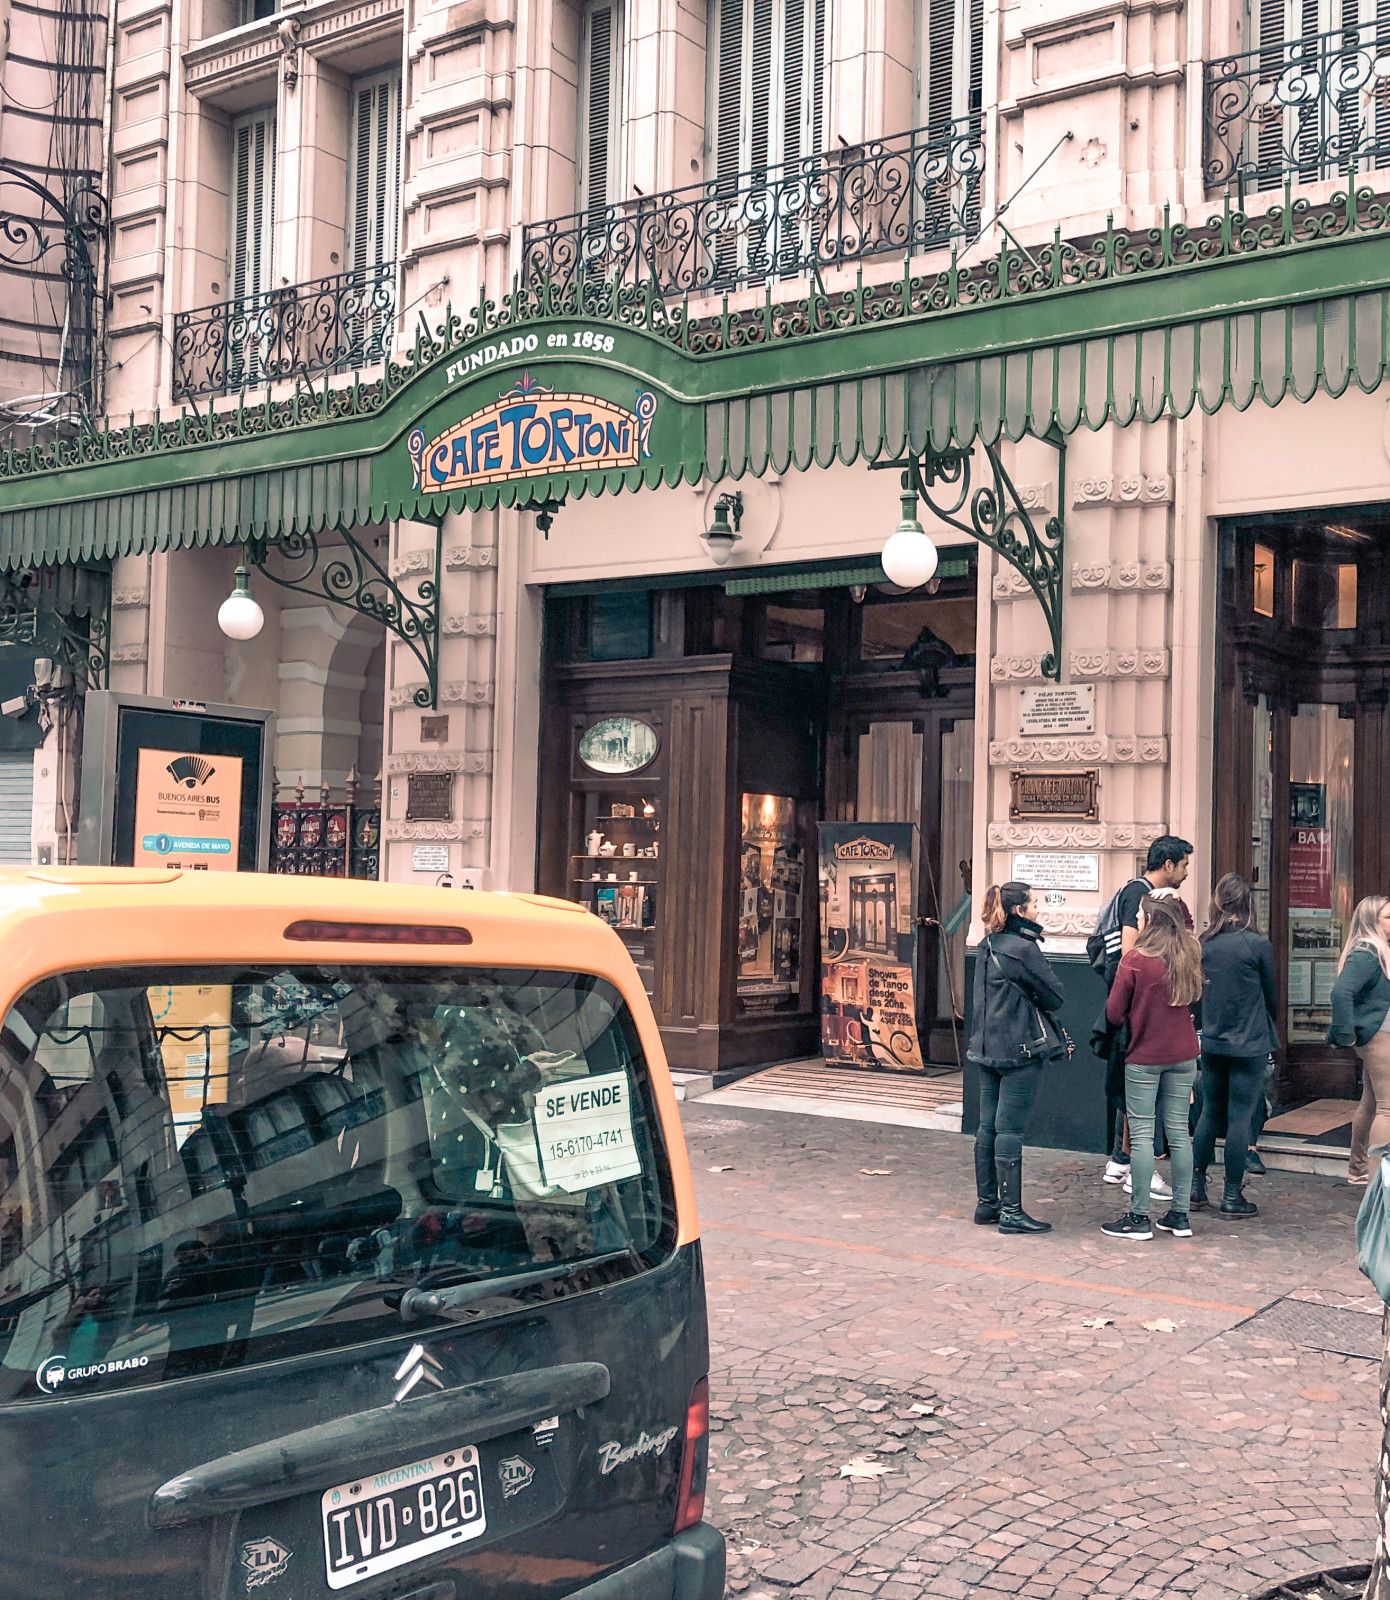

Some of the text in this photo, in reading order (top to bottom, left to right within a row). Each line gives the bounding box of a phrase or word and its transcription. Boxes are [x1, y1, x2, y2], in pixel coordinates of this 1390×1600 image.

[445, 331, 615, 384] FUNDADO en 1858
[499, 404, 631, 470] TORTONI
[158, 793, 220, 804] BUENOS AIRES BUS
[160, 838, 166, 849] 1
[173, 841, 201, 849] AVENIDA
[202, 842, 210, 850] DE
[211, 842, 230, 850] MAYO
[1298, 831, 1317, 845] BA
[858, 842, 889, 857] TORTONI
[868, 968, 898, 979] Shows
[869, 979, 909, 991] de Tango
[869, 989, 895, 998] desde
[870, 997, 882, 1007] las
[546, 1085, 621, 1118] SE VENDE
[550, 1128, 623, 1160] 15-6170-4741
[68, 1356, 149, 1380] GRUPO BRABO
[598, 1426, 679, 1475] Berlingo
[373, 1461, 435, 1489] ARGENTINA
[331, 1497, 398, 1567] IVD
[418, 1471, 478, 1534] 826
